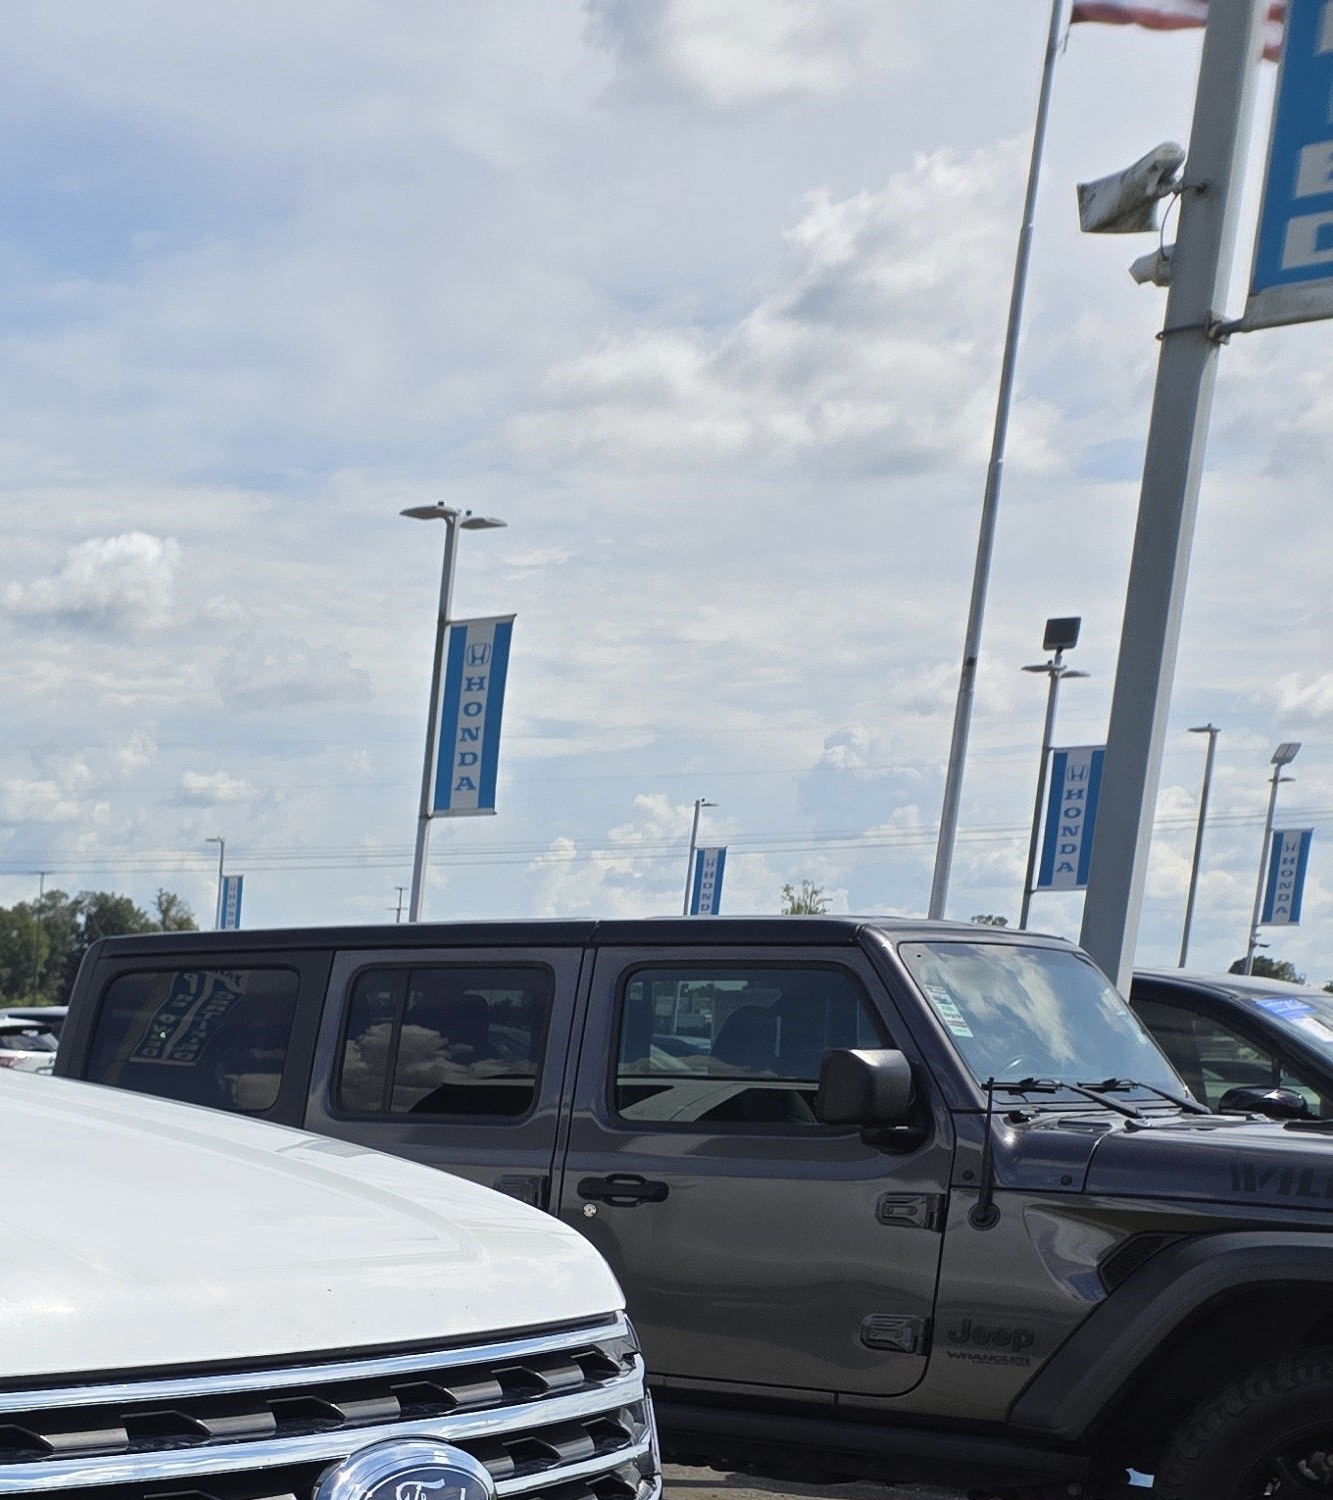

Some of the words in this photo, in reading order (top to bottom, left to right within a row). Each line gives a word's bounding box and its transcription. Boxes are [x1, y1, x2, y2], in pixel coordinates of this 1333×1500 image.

[454, 675, 486, 791] HONDA
[1056, 787, 1085, 873] HONDA
[700, 870, 715, 912] HOND
[1275, 857, 1296, 914] HONDA
[947, 1318, 1034, 1353] Jeep
